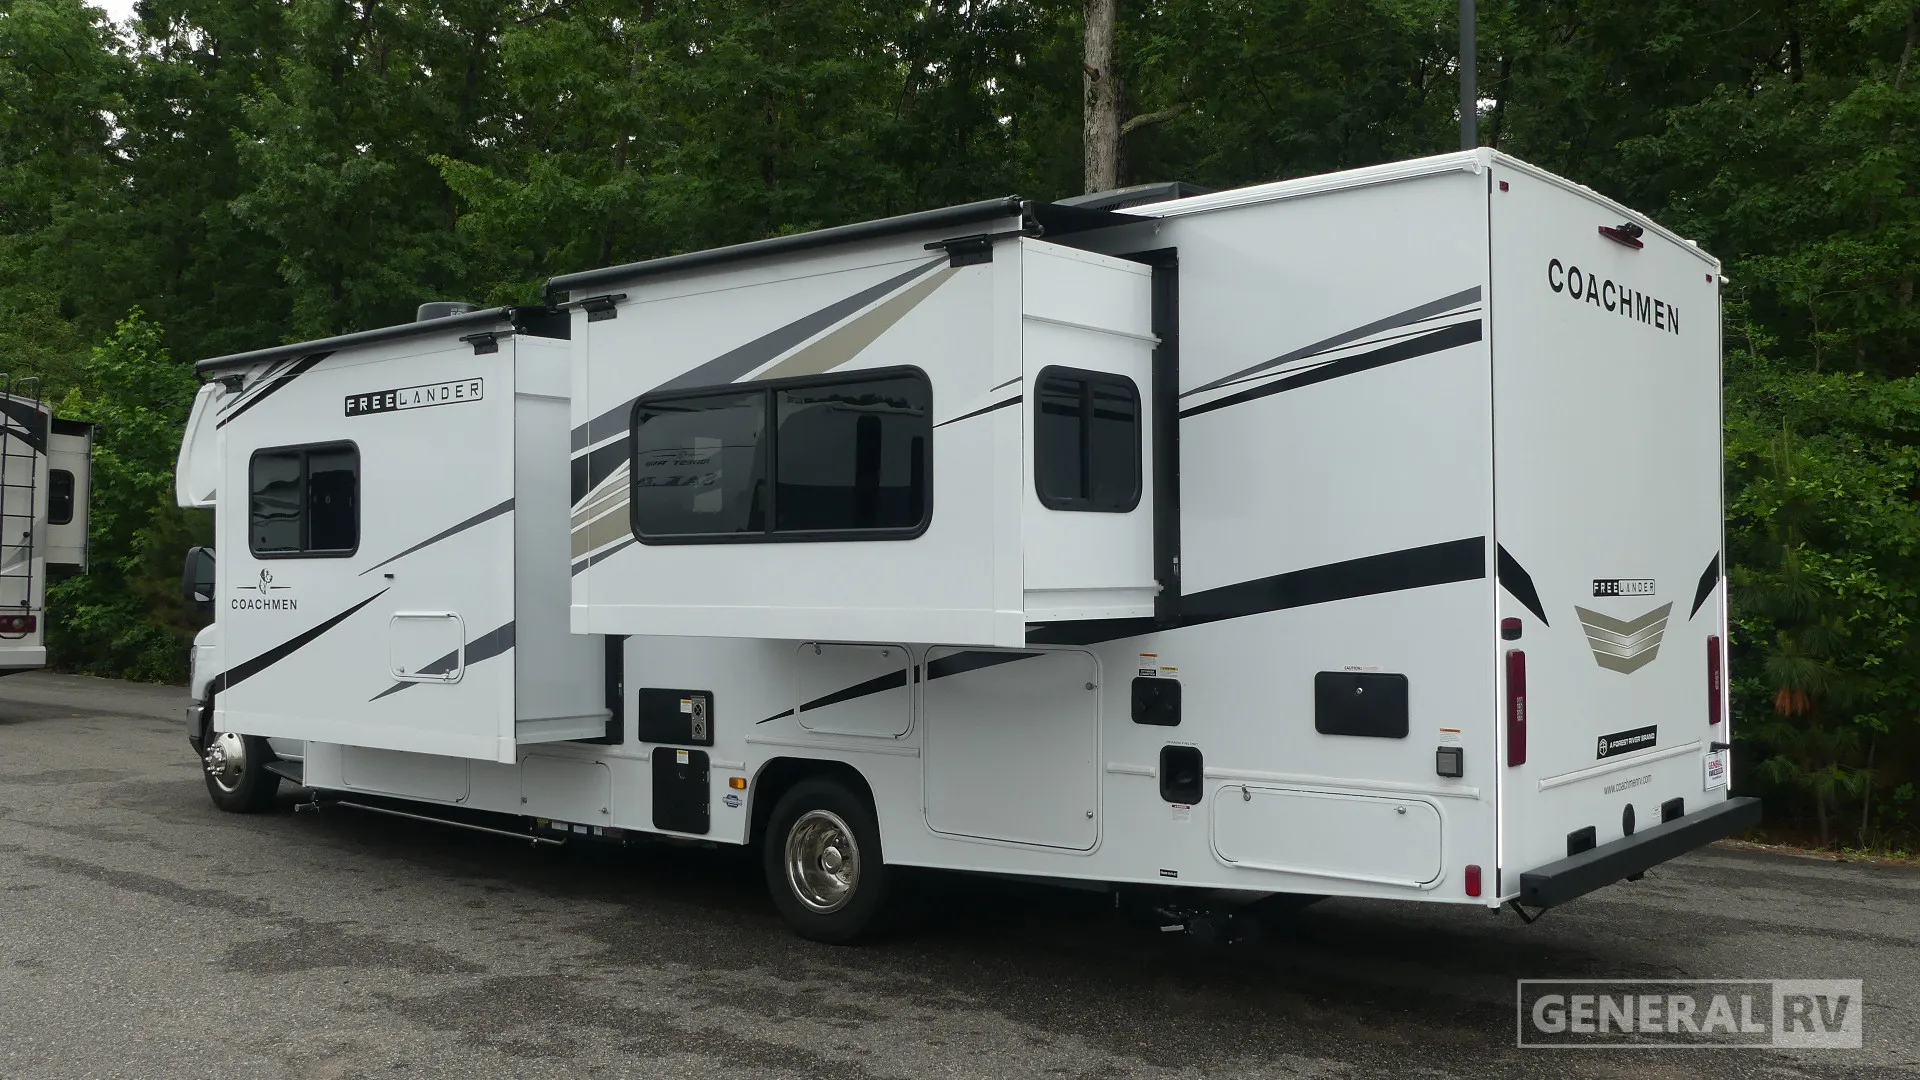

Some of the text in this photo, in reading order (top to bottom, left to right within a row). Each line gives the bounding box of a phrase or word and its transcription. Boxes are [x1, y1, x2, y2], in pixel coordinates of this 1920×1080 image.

[1548, 258, 1679, 336] COACHMEN
[347, 382, 479, 413] FREELANDER
[231, 598, 298, 610] COACHMEN
[1613, 738, 1629, 747] FOREST
[1629, 735, 1641, 744] RIVER
[1641, 732, 1655, 741] BRAND
[1603, 774, 1652, 795] www.coachmenrv.com
